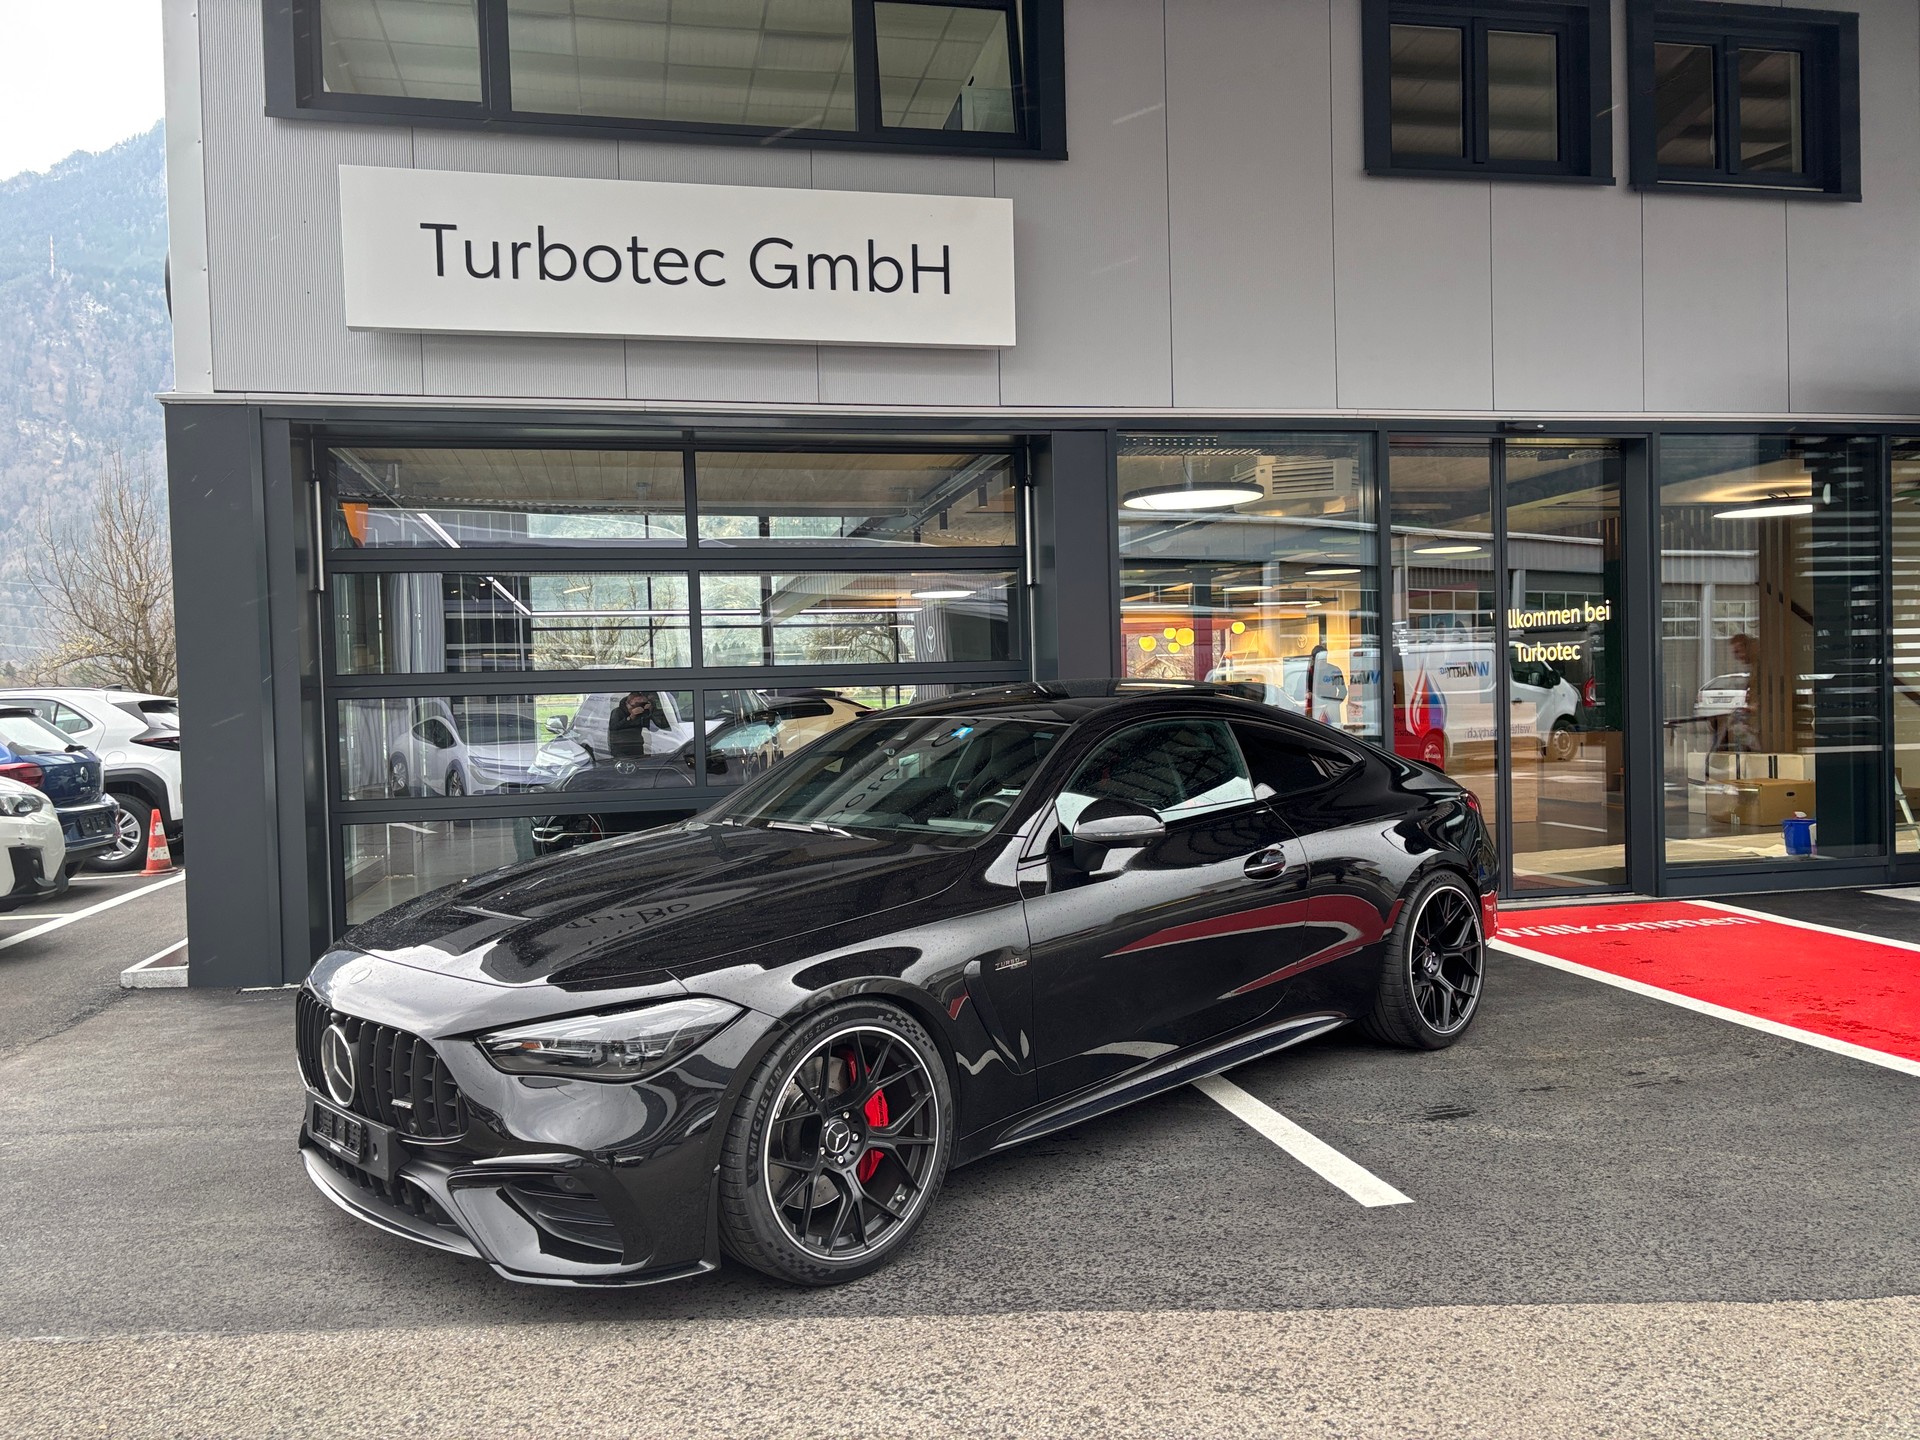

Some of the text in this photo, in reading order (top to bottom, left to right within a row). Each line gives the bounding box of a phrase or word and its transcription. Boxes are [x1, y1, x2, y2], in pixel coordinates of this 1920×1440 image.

[420, 222, 951, 295] Turbotec GmbH
[1489, 599, 1611, 629] llkommen bei
[1515, 641, 1581, 663] Turbotec
[1497, 915, 1761, 938] Willkommen
[828, 1015, 839, 1026] 20
[749, 1064, 783, 1157] MICHELIN
